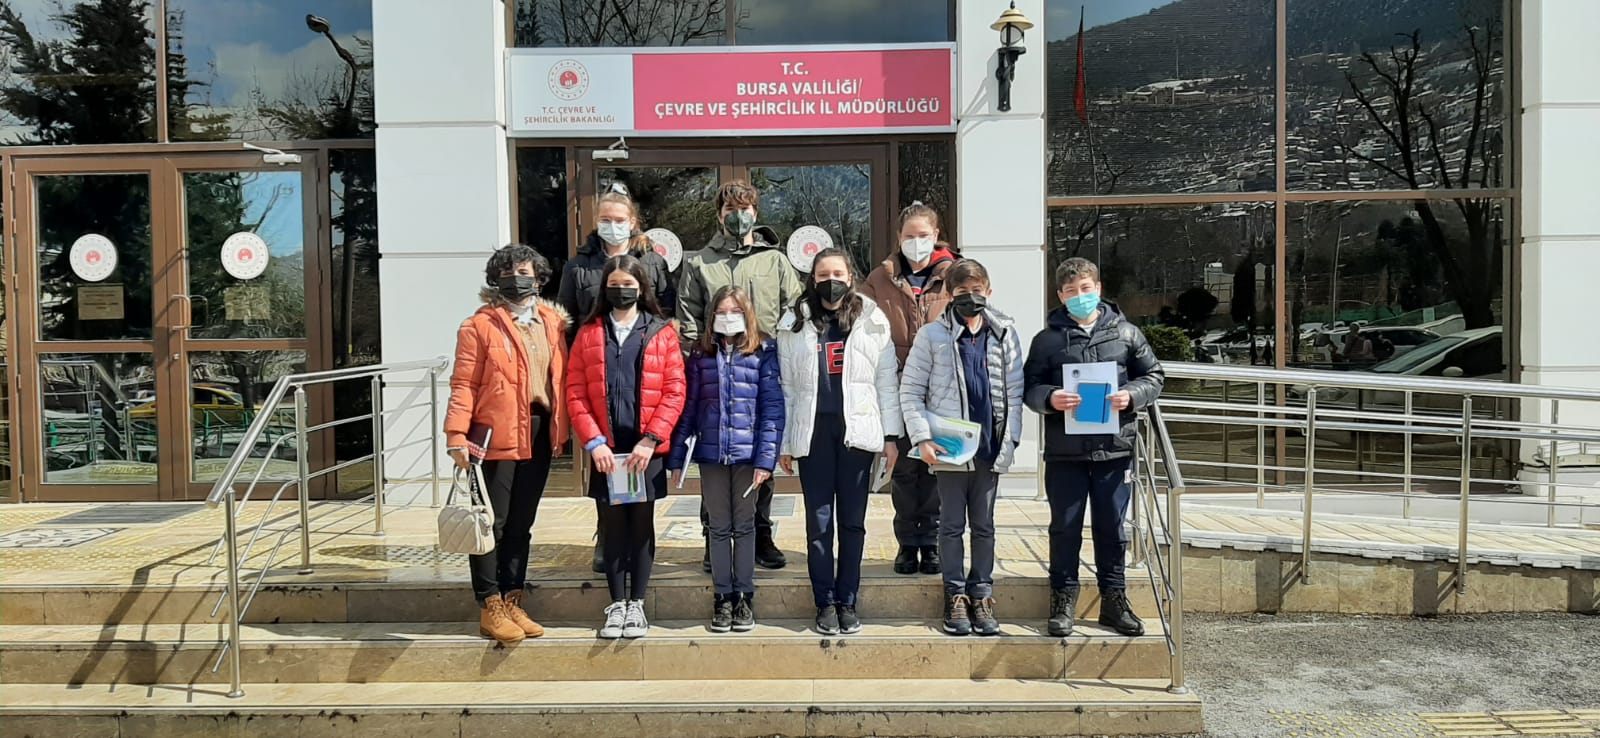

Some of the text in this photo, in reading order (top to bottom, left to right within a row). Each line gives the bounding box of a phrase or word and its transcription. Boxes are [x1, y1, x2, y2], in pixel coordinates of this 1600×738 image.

[780, 62, 809, 75] T.C.
[736, 80, 857, 96] BURSA VALİLİĞİ
[542, 106, 555, 114] T.C.
[558, 106, 583, 115] ÇEVRE
[654, 97, 940, 119] ÇEVRE VE ŞEHİRCİLİK İL MÜDÜRLÜĞÜ
[524, 114, 615, 125] ŞEHİRCİLİK BAKANLIĞI
